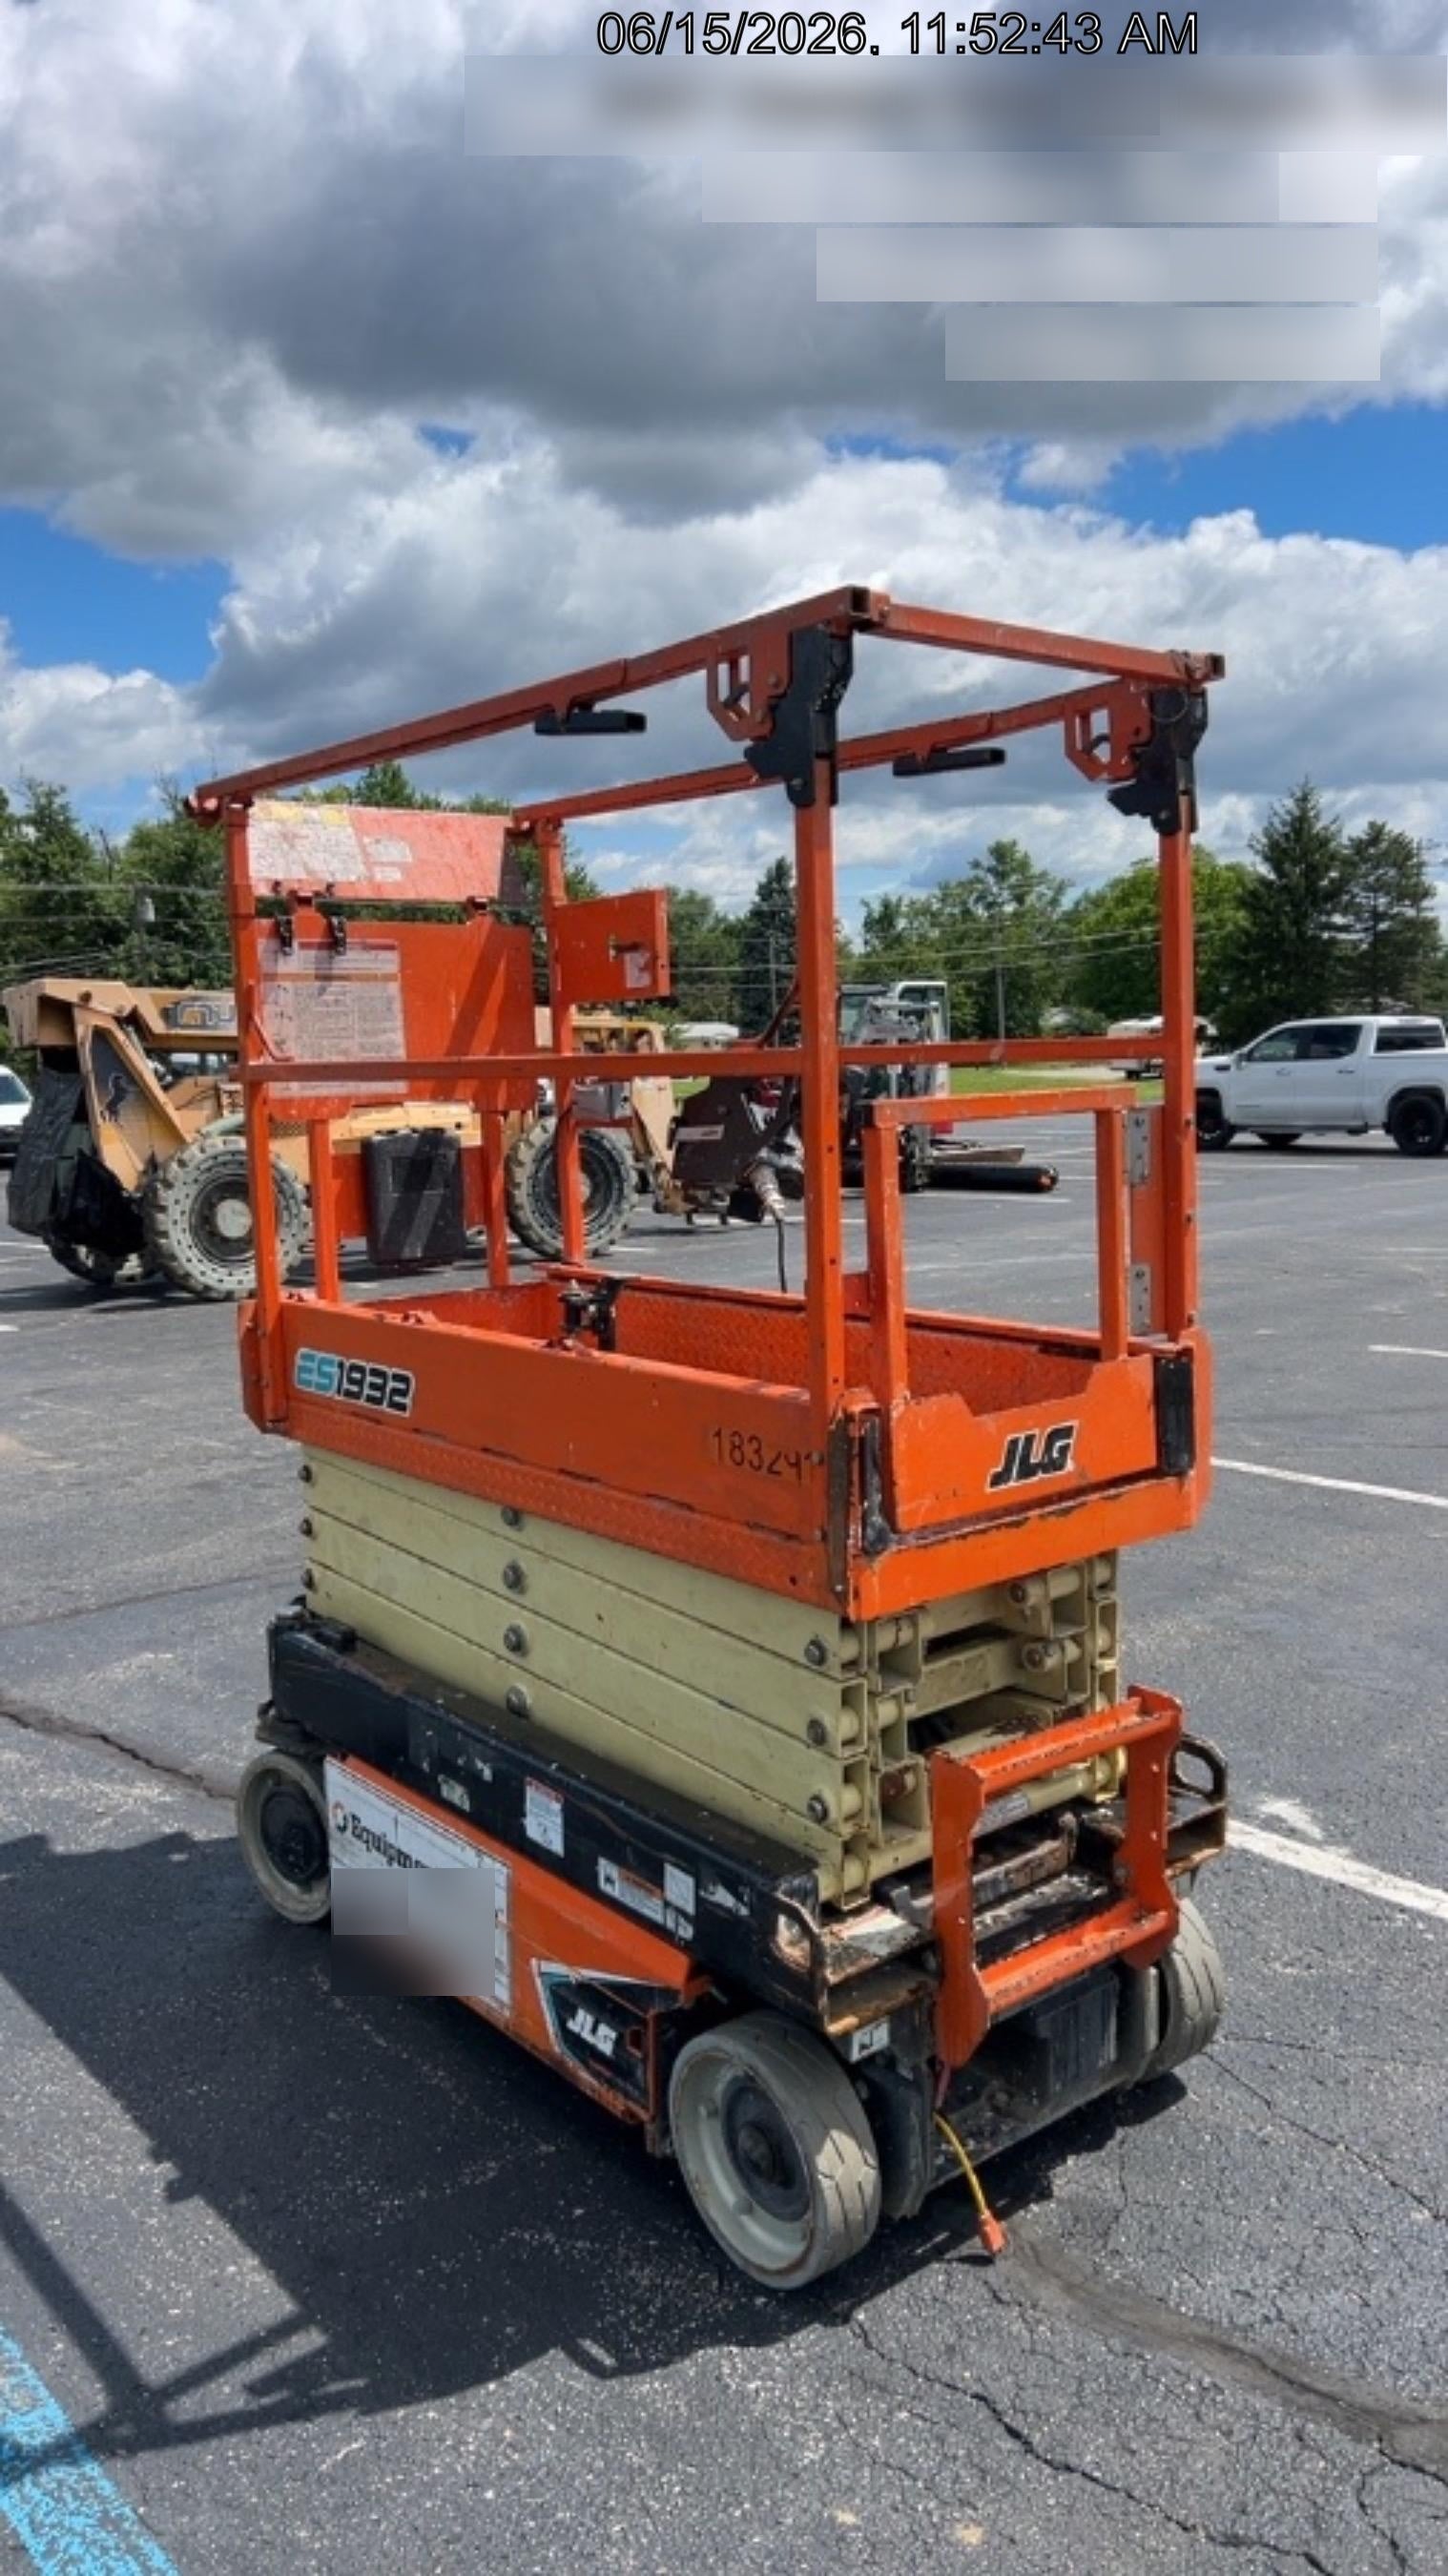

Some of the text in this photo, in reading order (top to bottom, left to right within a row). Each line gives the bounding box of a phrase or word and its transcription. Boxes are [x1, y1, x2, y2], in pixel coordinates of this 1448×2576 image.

[297, 1350, 412, 1413] ES1932
[987, 1423, 1075, 1489] JLG
[566, 2006, 617, 2057] JLG
